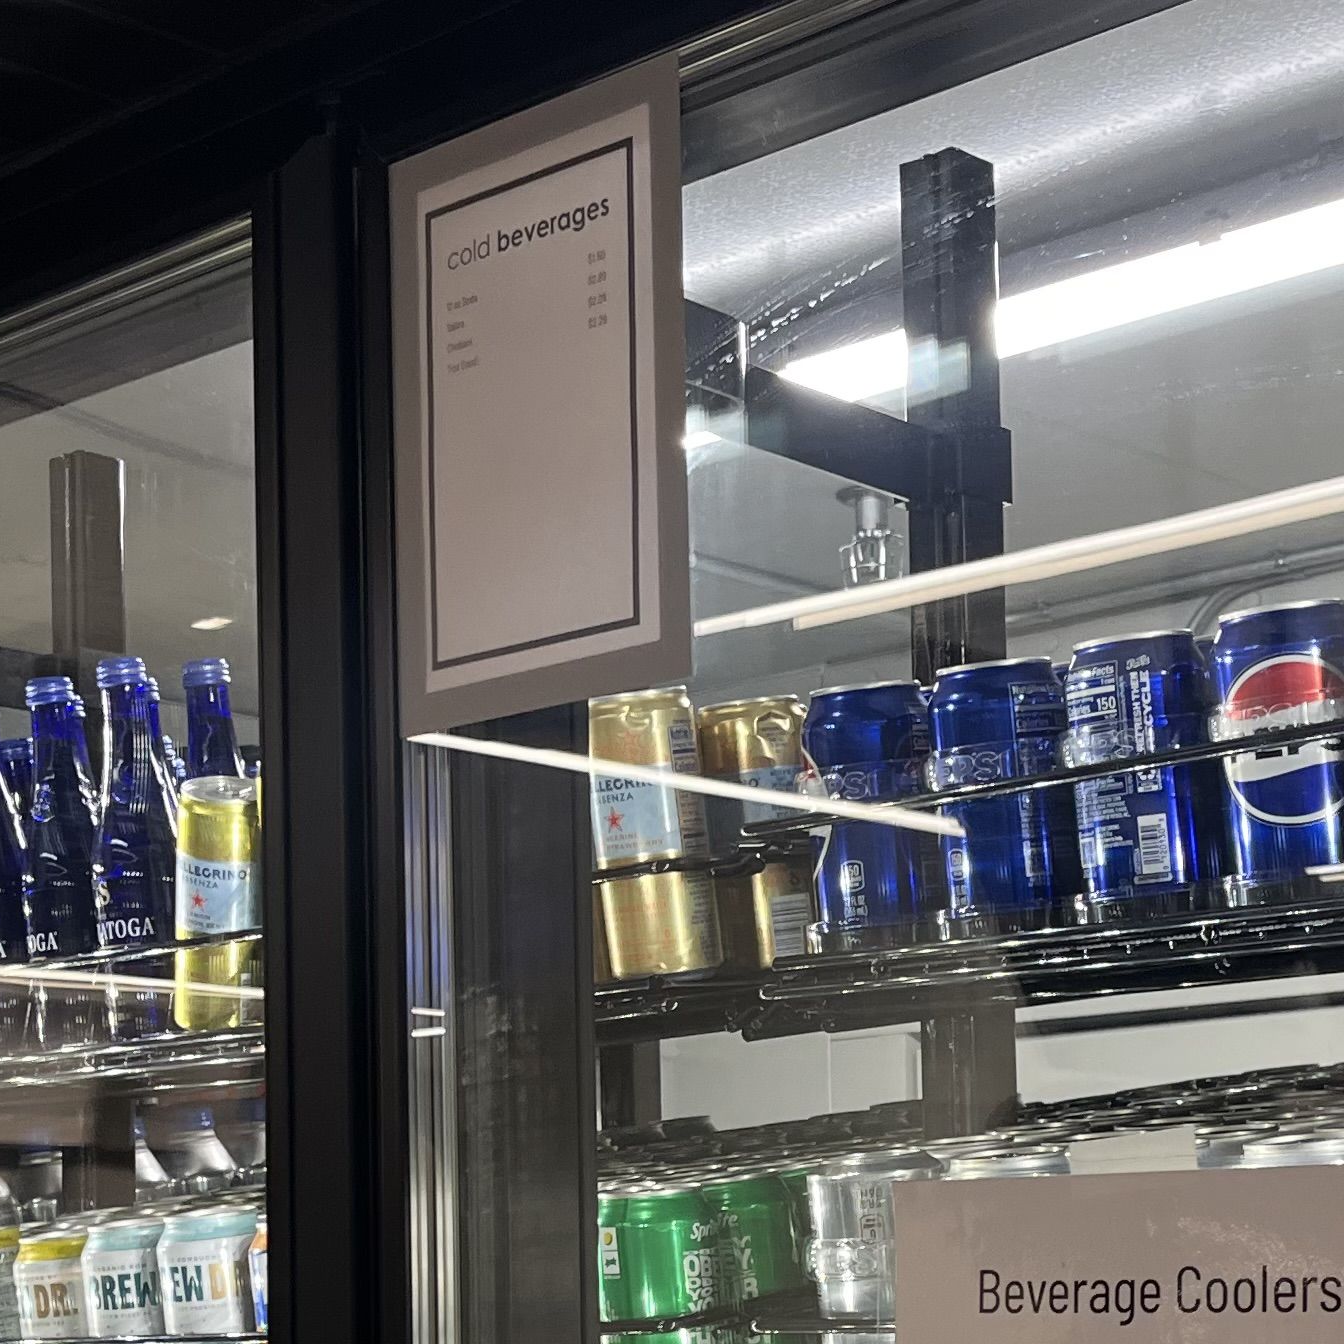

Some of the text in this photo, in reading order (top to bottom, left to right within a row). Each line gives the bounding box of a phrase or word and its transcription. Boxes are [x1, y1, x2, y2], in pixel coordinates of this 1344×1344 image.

[447, 197, 610, 270] cold beverages
[1096, 696, 1117, 711] 150
[980, 1266, 1341, 1326] Beverage Coolers
